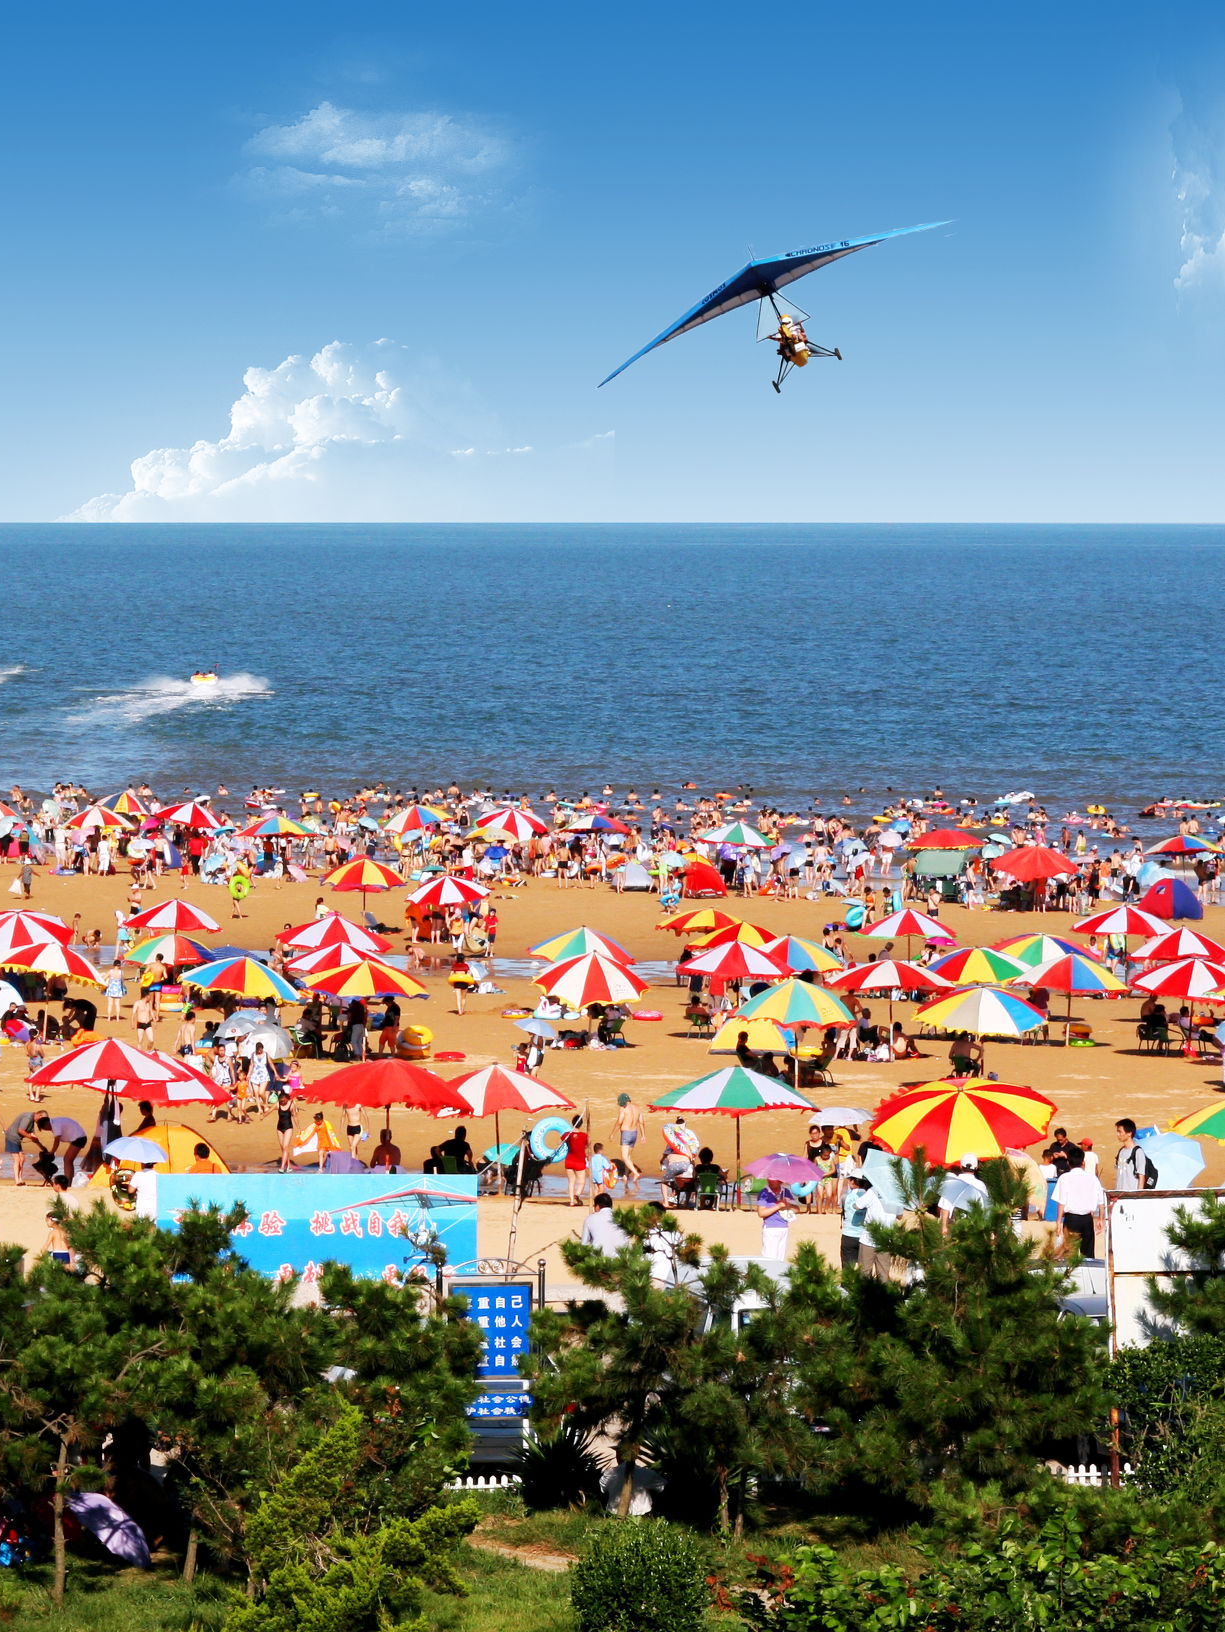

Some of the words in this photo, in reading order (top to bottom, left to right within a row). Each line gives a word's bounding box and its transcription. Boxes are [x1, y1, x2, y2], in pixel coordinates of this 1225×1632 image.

[840, 240, 850, 248] 16
[309, 1208, 408, 1238] 挑战自我
[464, 1315, 523, 1328] 重他人
